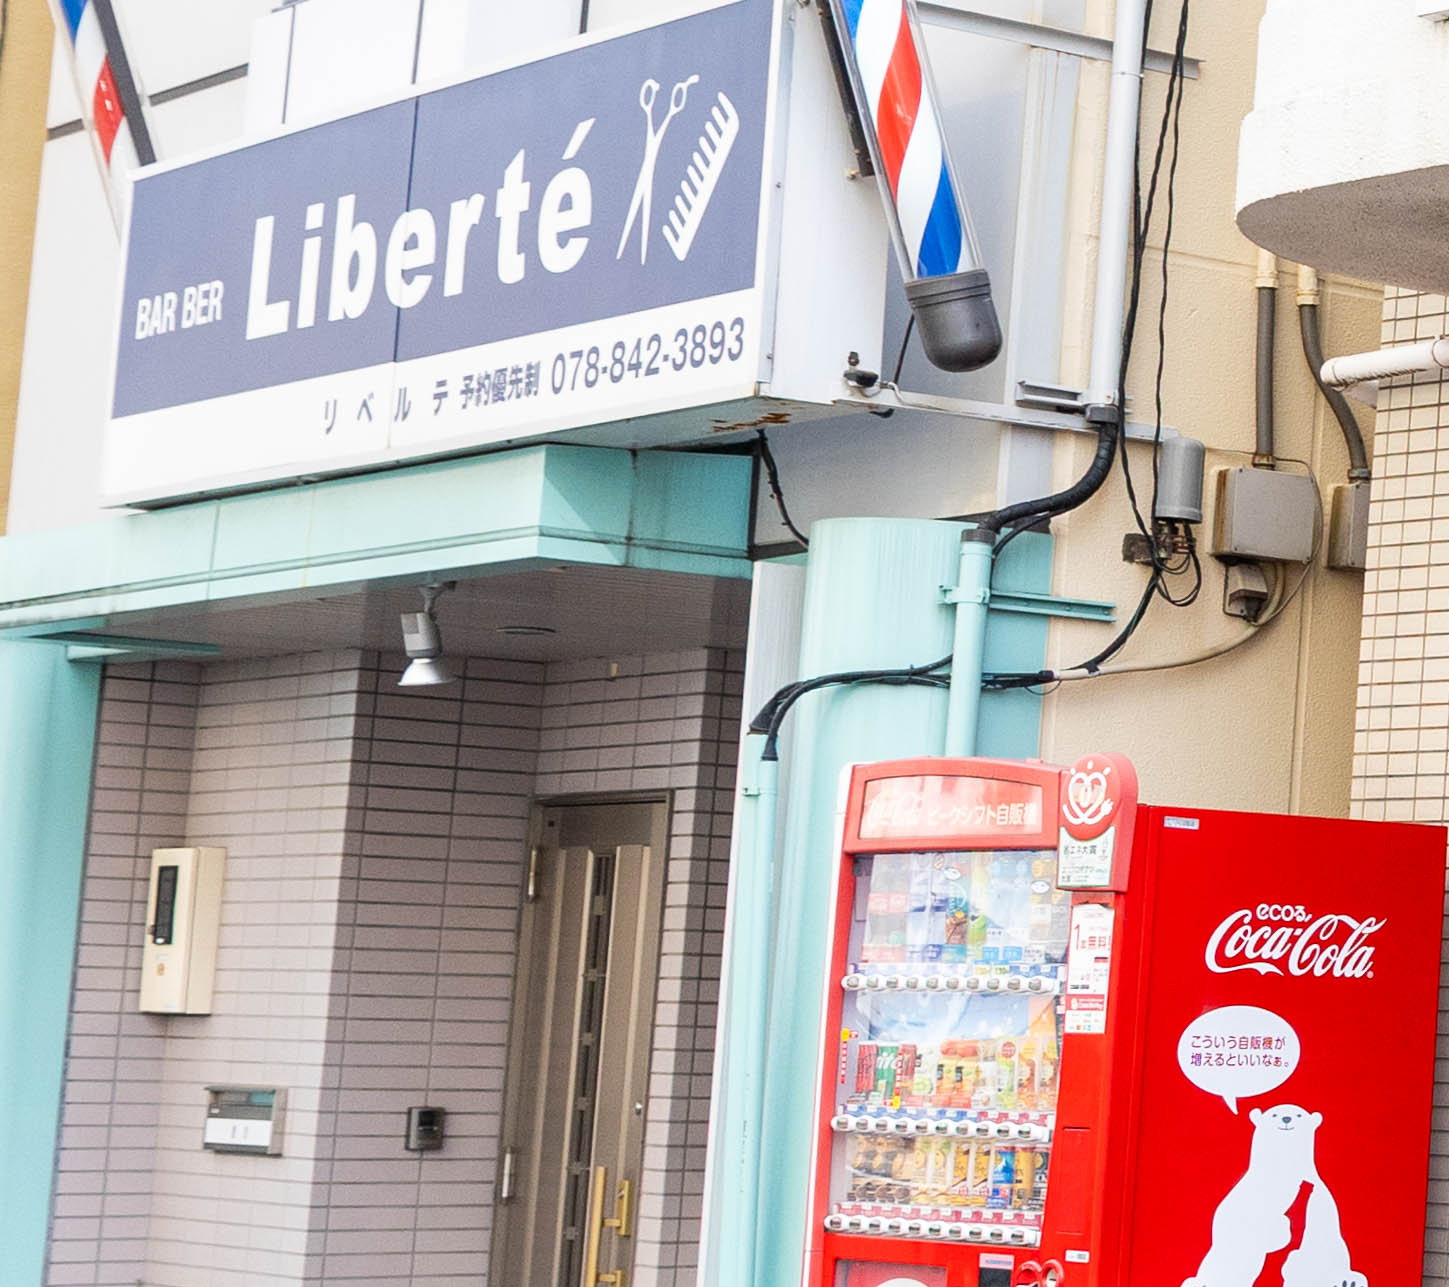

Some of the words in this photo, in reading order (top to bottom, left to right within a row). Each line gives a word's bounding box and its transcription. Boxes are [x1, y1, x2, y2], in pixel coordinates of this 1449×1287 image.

[246, 117, 595, 340] Liberté
[550, 317, 745, 396] 078-842-3893
[1205, 909, 1387, 978] Coca-Cola
[1191, 1035, 1286, 1050] こういう自販機が
